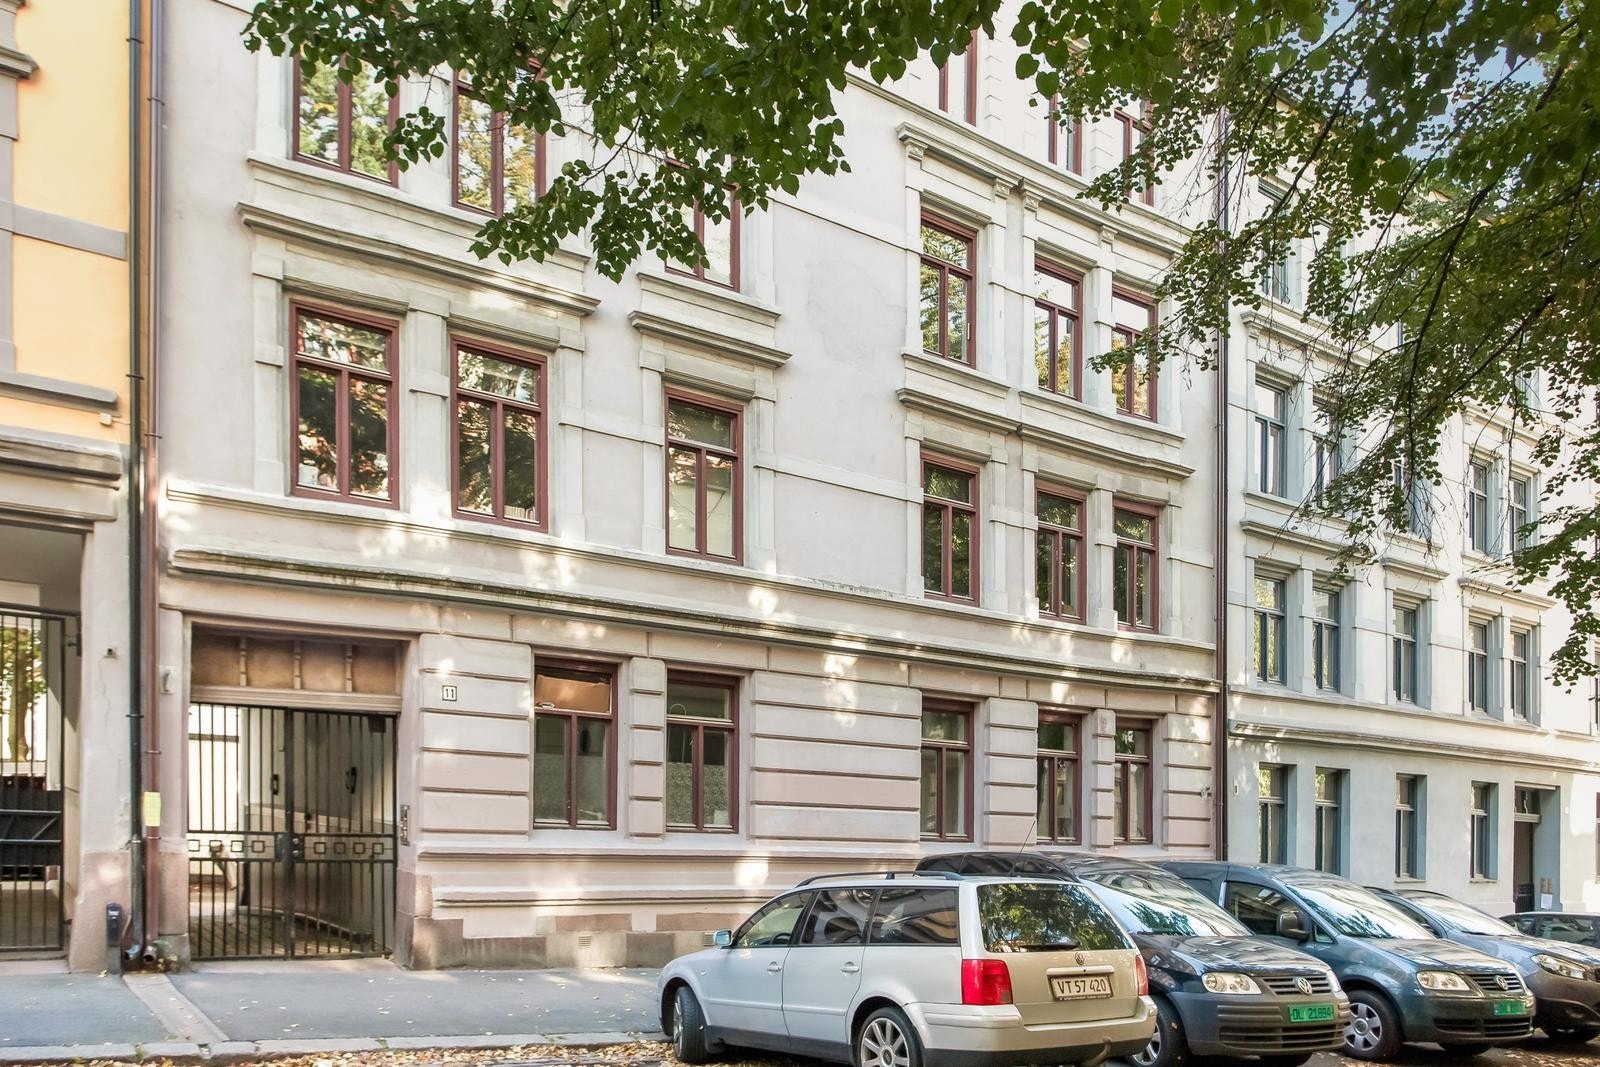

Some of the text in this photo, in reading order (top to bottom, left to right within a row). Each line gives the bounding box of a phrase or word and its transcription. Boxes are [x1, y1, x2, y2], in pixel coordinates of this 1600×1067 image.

[445, 688, 454, 698] 11
[1057, 978, 1107, 994] VT 57 420
